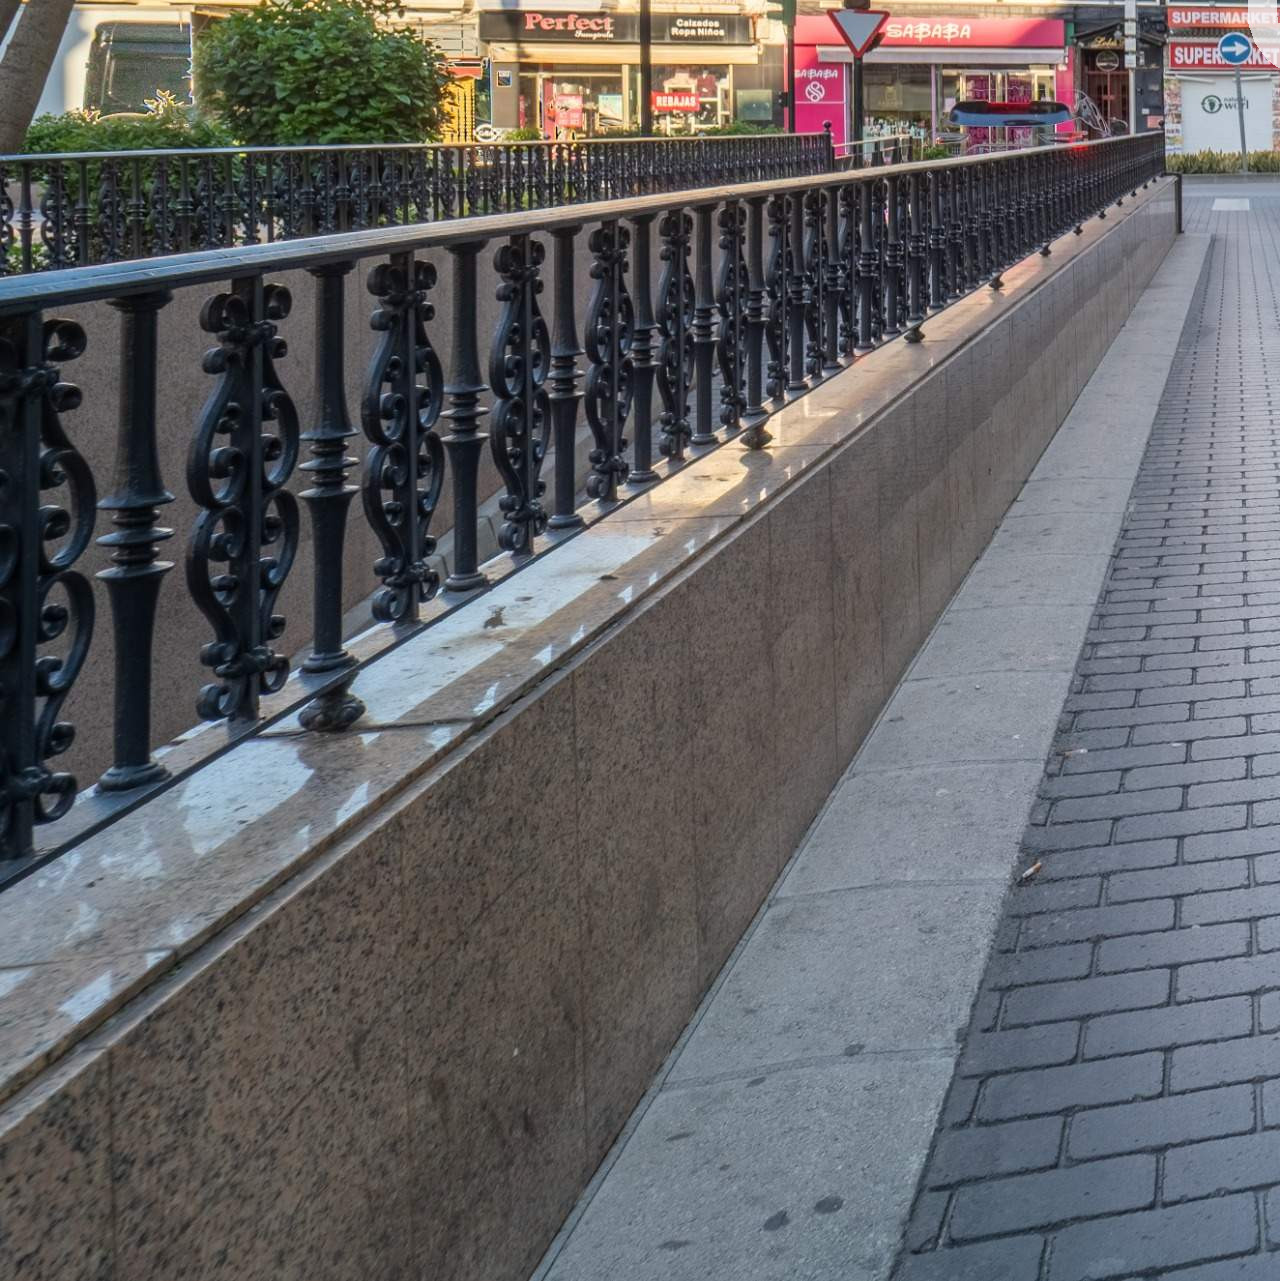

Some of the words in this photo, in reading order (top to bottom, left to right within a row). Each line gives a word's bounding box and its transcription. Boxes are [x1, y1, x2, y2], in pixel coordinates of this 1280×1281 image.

[524, 13, 614, 31] Perfect
[676, 19, 720, 28] Calzados
[1172, 11, 1280, 24] SUPERMARKET
[671, 27, 696, 37] Ropa
[698, 26, 725, 37] Niños
[886, 23, 971, 41] SABABA
[1174, 46, 1280, 65] SUPERRKET
[655, 95, 697, 107] REBAJAS
